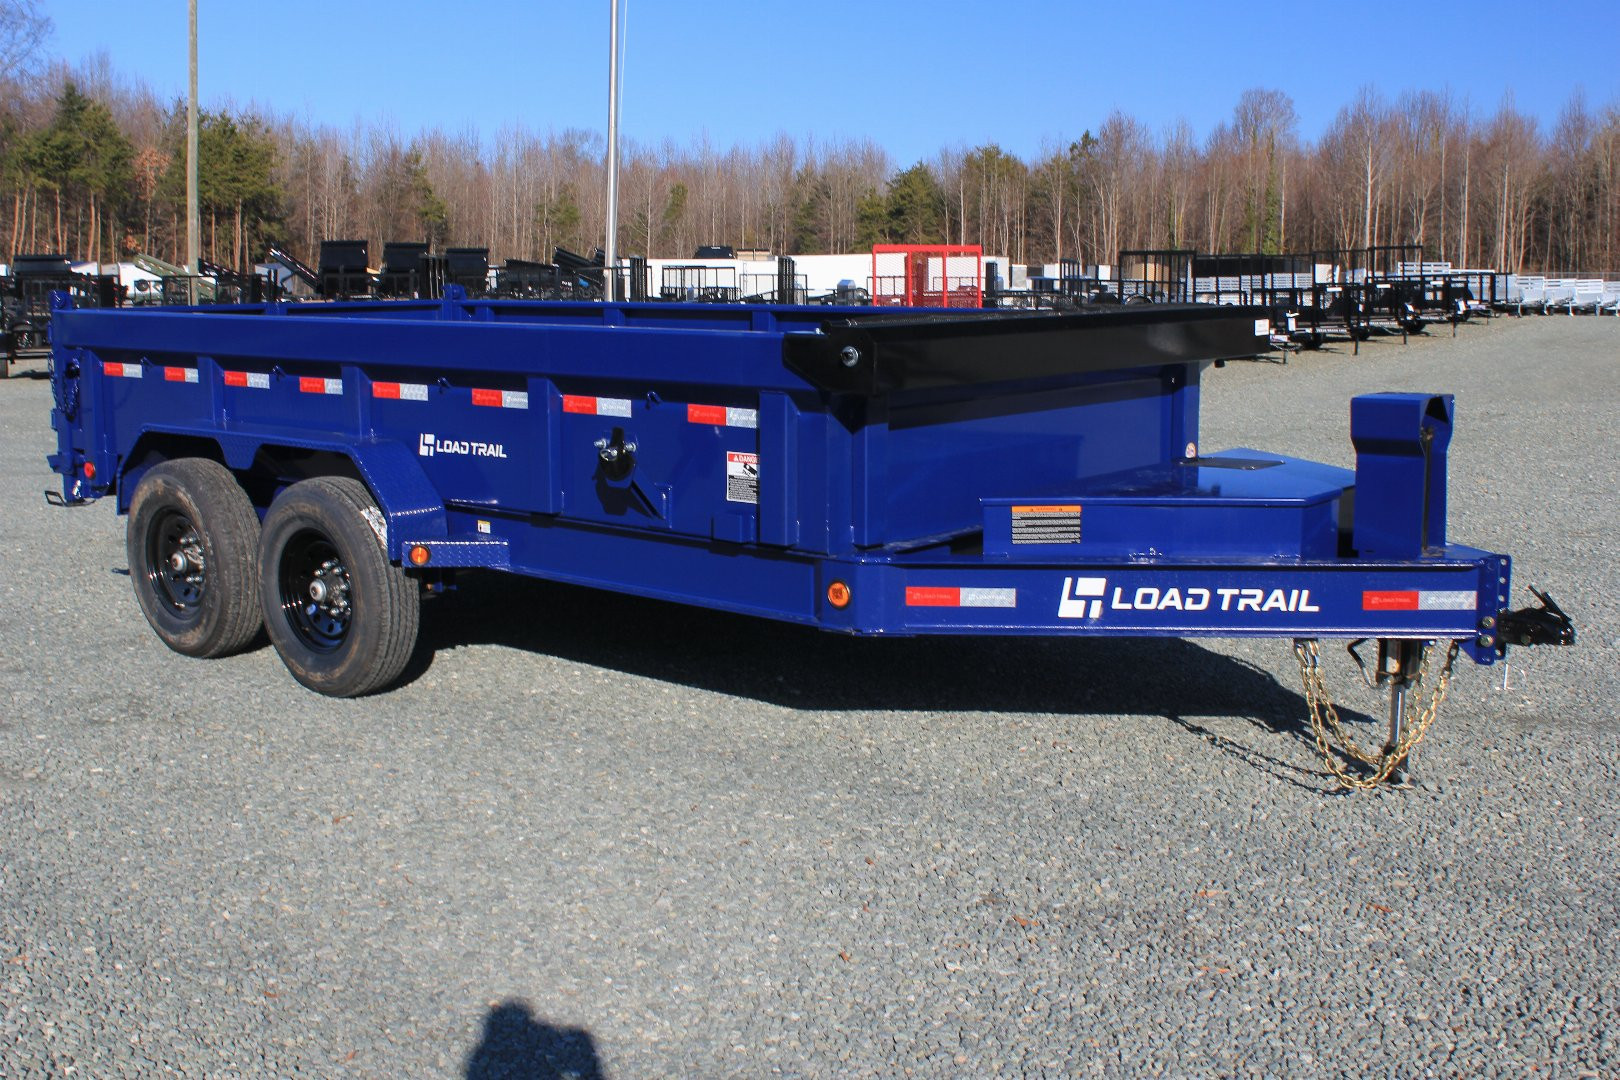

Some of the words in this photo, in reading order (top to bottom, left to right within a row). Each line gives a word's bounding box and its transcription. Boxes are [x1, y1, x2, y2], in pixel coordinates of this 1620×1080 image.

[436, 439, 469, 455] LOAD
[470, 442, 507, 458] TRAIL
[1111, 587, 1211, 610] LOAD
[1217, 588, 1320, 612] TRAIL
